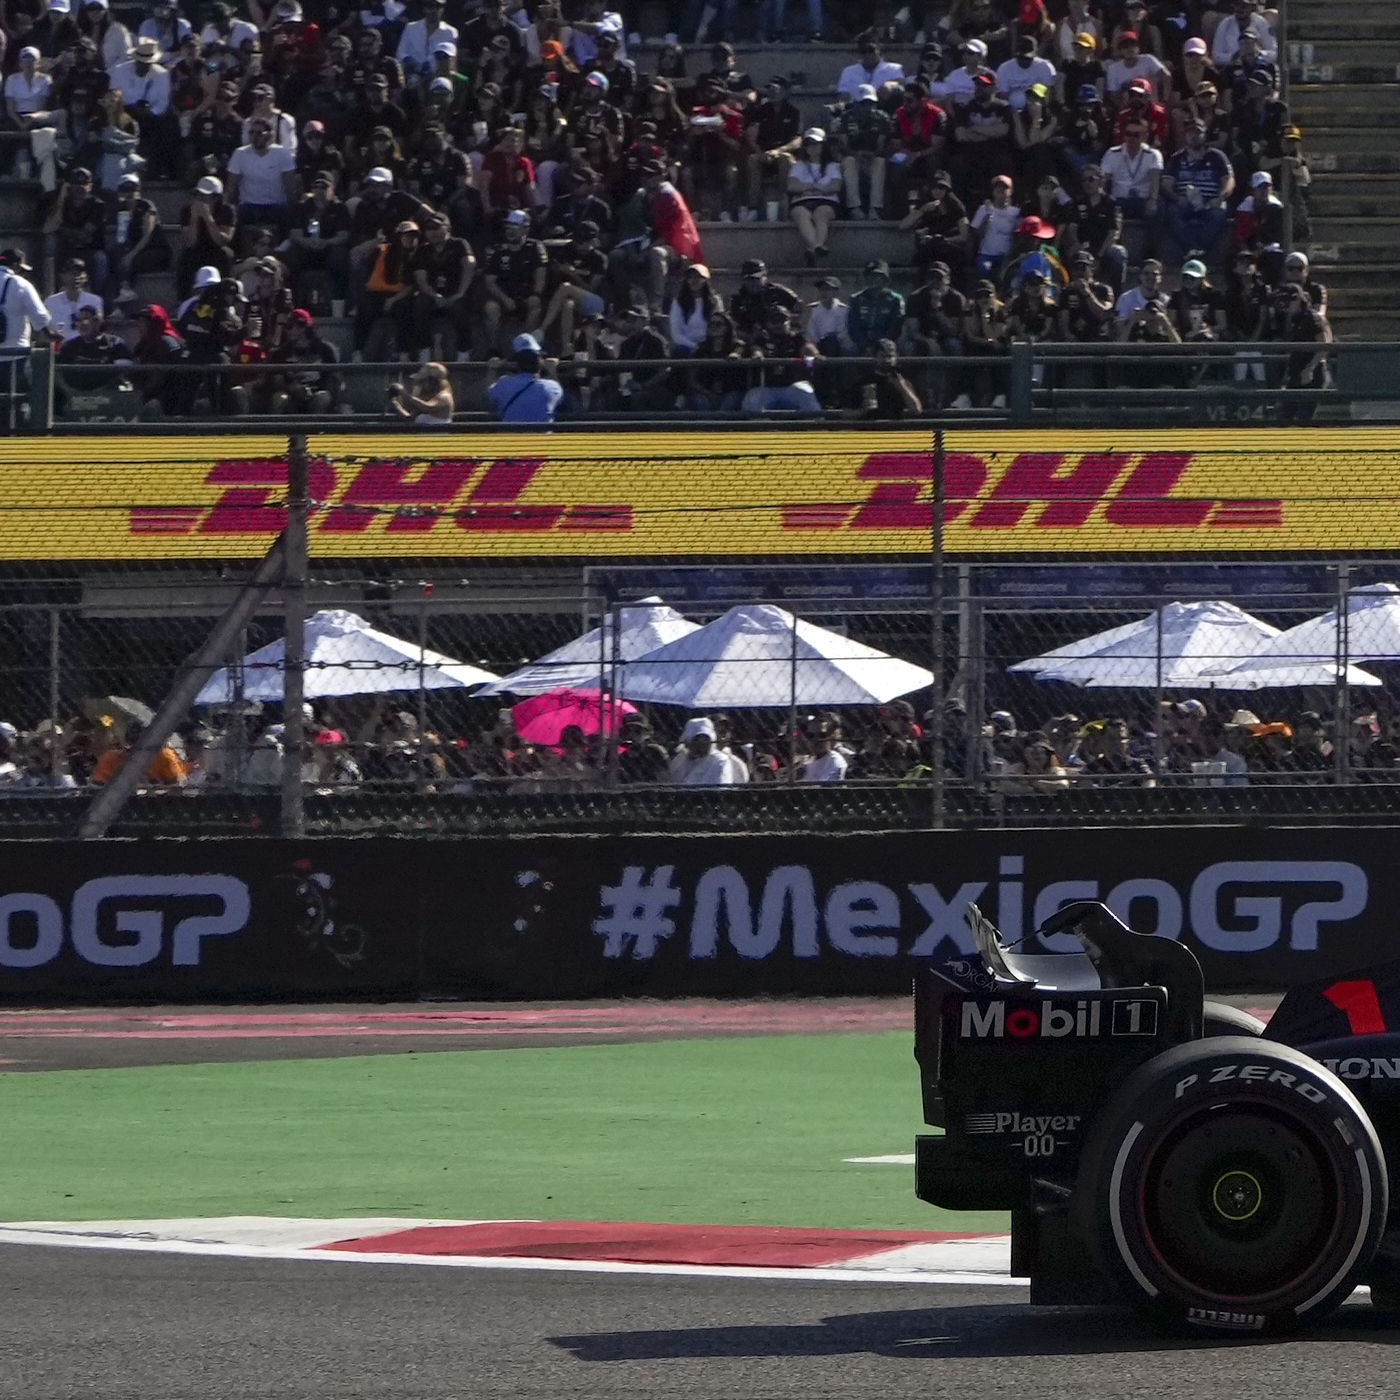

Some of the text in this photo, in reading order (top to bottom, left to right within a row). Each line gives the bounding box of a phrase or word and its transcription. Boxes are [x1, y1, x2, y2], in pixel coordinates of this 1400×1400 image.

[199, 455, 567, 533] DHL
[851, 451, 1213, 528] DHL
[592, 854, 1368, 961] #MexicoGP
[960, 1001, 1101, 1038] Mobil
[1322, 979, 1386, 1035] 1
[1175, 1064, 1329, 1104] P ZERO
[995, 1112, 1081, 1136] Player
